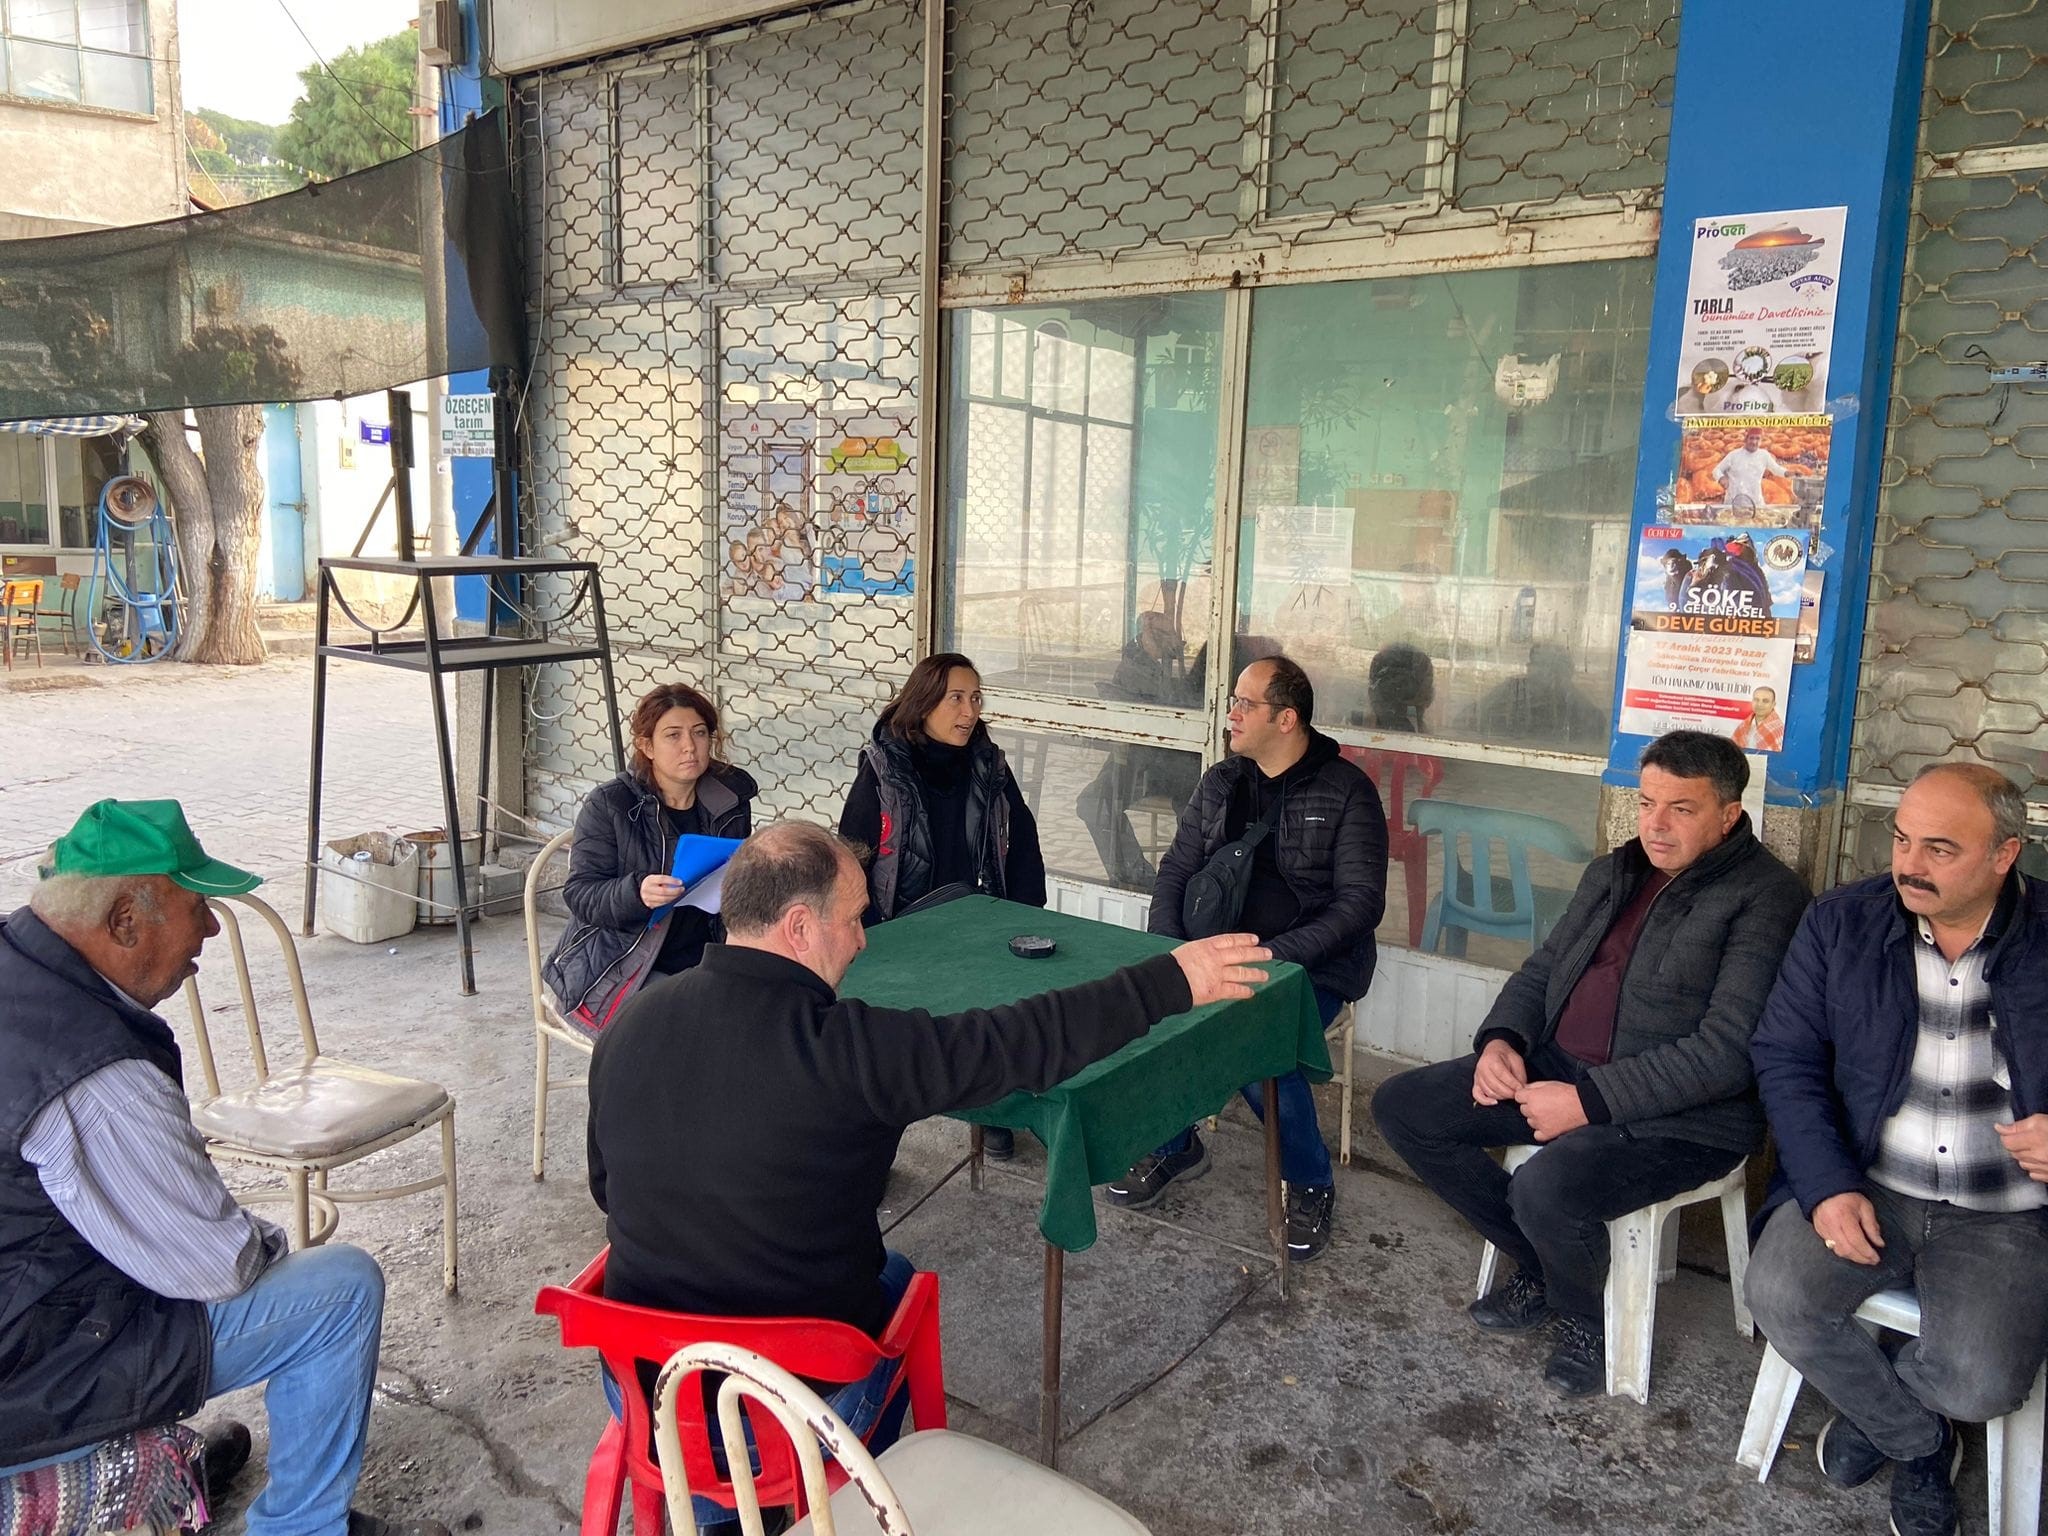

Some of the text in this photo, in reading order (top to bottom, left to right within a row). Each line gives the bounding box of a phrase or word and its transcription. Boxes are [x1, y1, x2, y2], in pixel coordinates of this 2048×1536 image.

[1697, 224, 1746, 239] ProGen
[1693, 297, 1734, 315] TARLA
[445, 397, 491, 417] ÖZGEÇEN
[454, 417, 483, 429] tarım
[1687, 584, 1754, 608] SÖKE
[1669, 602, 1766, 619] 9. GELENEKSEL
[1656, 615, 1780, 639] DEVE GÜREŞİ
[1670, 642, 1701, 653] Aralık
[1703, 645, 1732, 656] 2023
[1735, 647, 1768, 658] Pazar
